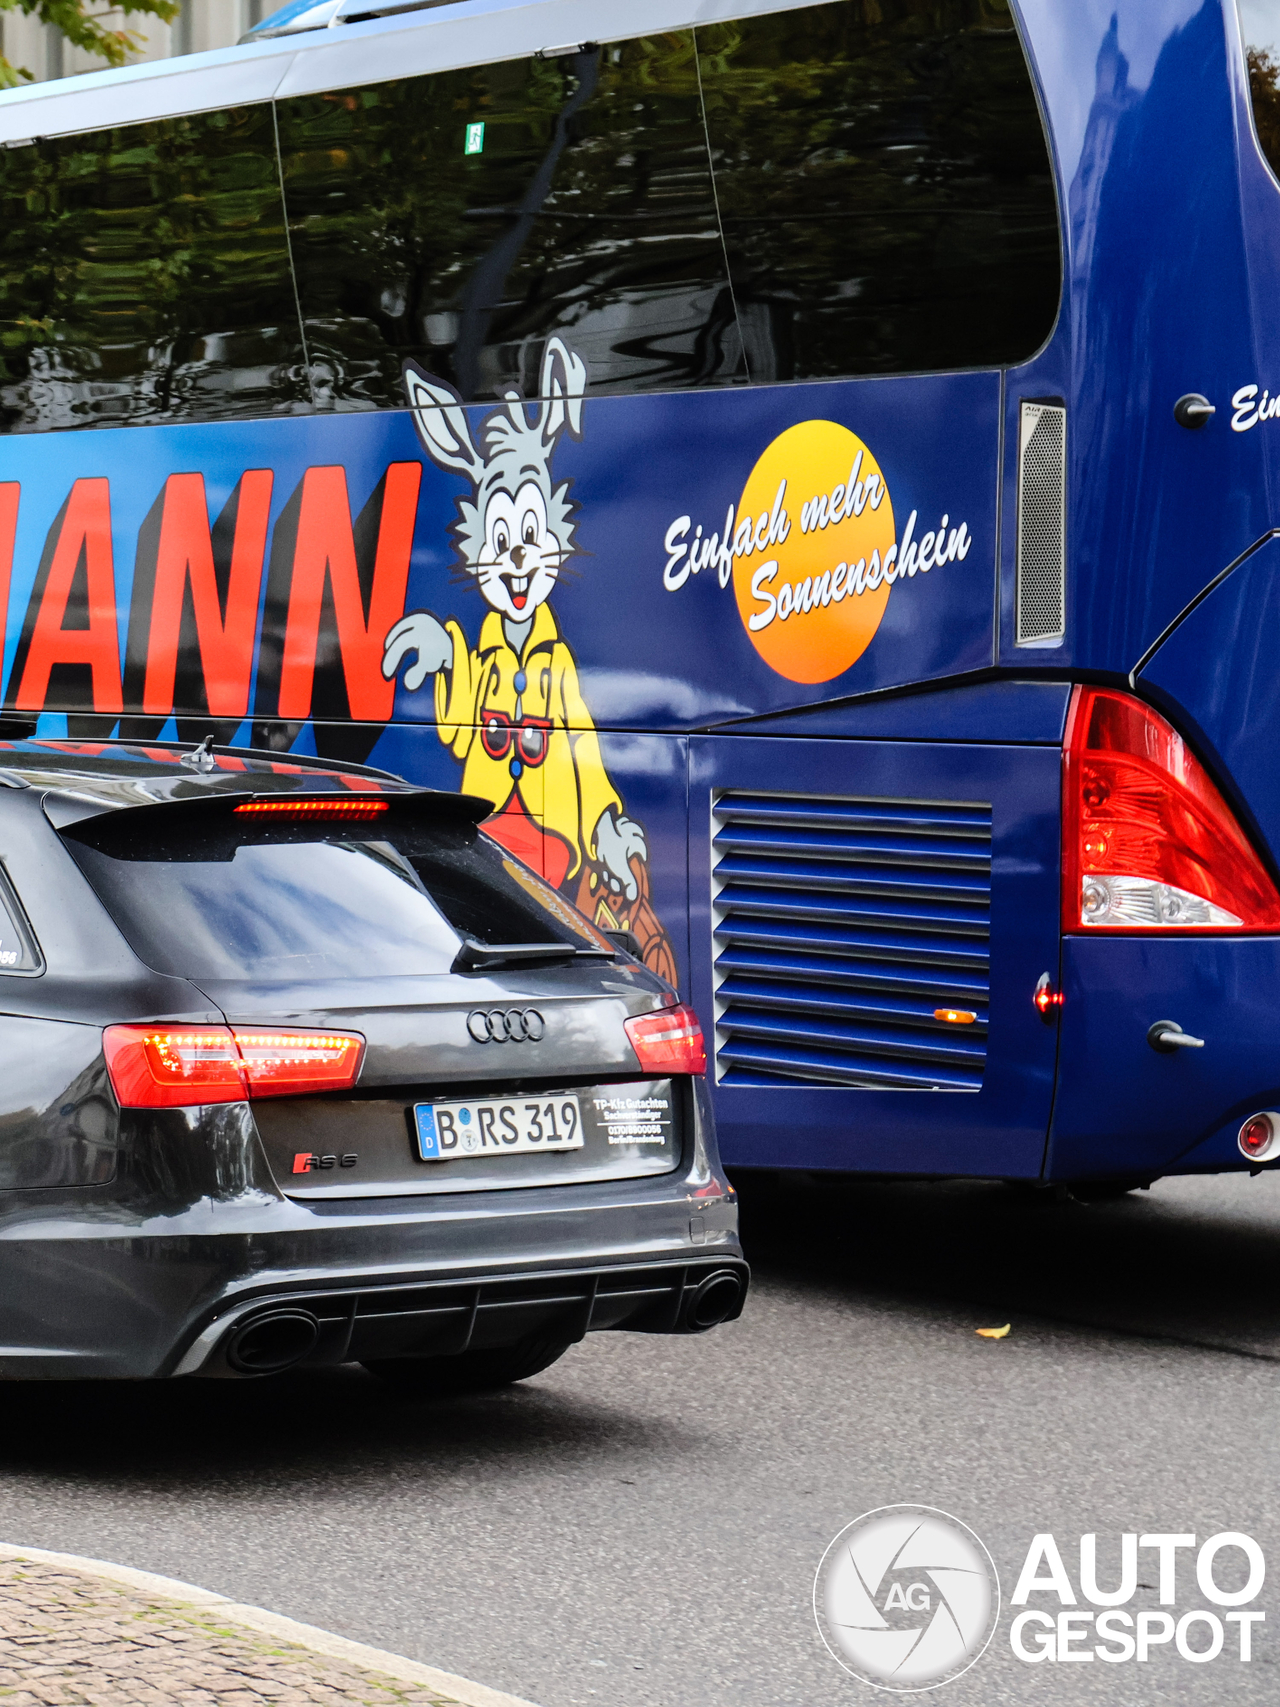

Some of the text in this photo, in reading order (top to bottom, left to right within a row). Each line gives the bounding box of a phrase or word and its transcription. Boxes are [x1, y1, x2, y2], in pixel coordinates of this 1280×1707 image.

[664, 450, 885, 591] Einfach mehr
[748, 510, 972, 632] Sonnenschein
[625, 1097, 669, 1109] Gutachten
[436, 1102, 577, 1149] B RS 319
[425, 1137, 434, 1149] D
[299, 1154, 337, 1170] RS
